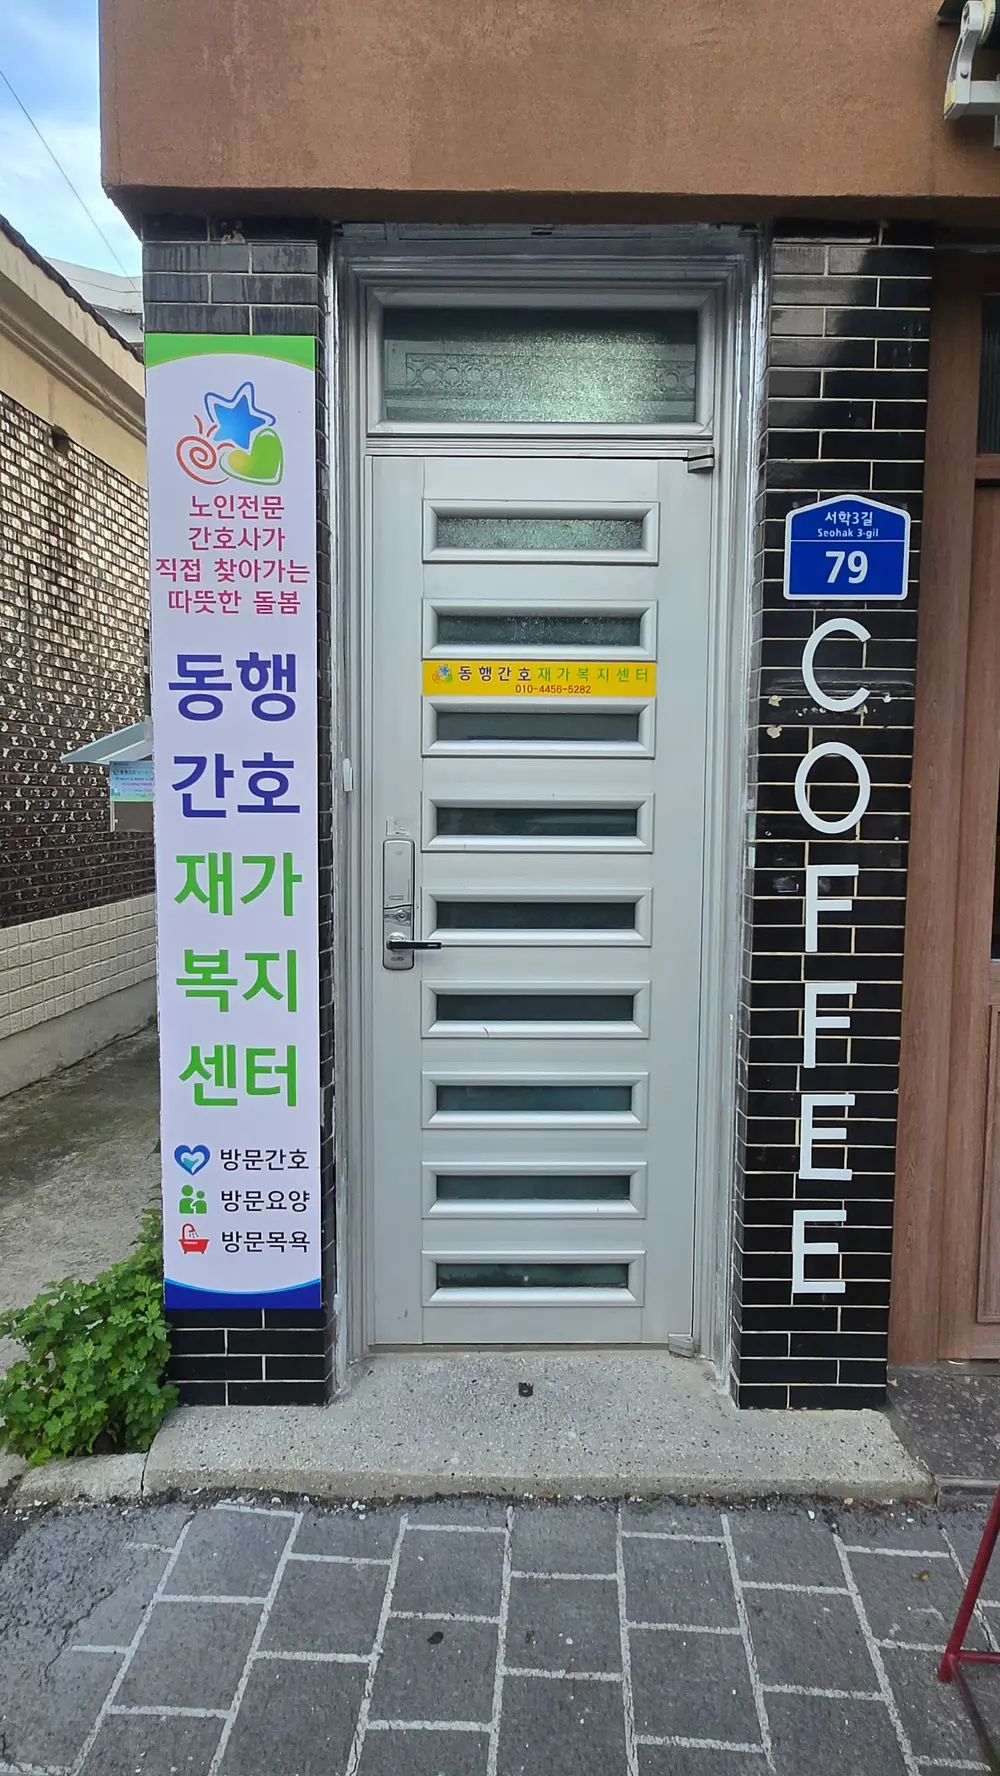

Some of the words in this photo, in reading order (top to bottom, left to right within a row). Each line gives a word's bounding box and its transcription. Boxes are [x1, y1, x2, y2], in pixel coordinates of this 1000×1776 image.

[188, 494, 285, 520] 노인전문
[824, 511, 873, 527] 서학3길
[188, 526, 286, 552] 간호사가
[817, 528, 854, 538] Seohak
[857, 528, 879, 540] 3-gil
[155, 557, 202, 583] 직접
[214, 557, 311, 584] 찾아가는
[825, 550, 868, 584] 79
[168, 589, 242, 614] 따뜻한
[252, 590, 301, 615] 돌봄
[168, 651, 298, 722] 동행
[515, 684, 592, 695] 010-4456-5282
[171, 751, 301, 819] 간호
[173, 851, 303, 917] 재가
[792, 617, 873, 1294] COFFEE
[175, 947, 298, 1013] 복지
[178, 1044, 297, 1108] 센터
[219, 1148, 310, 1172] 방문간호
[220, 1189, 311, 1213] 방문요양
[221, 1230, 311, 1254] 방문목욕
